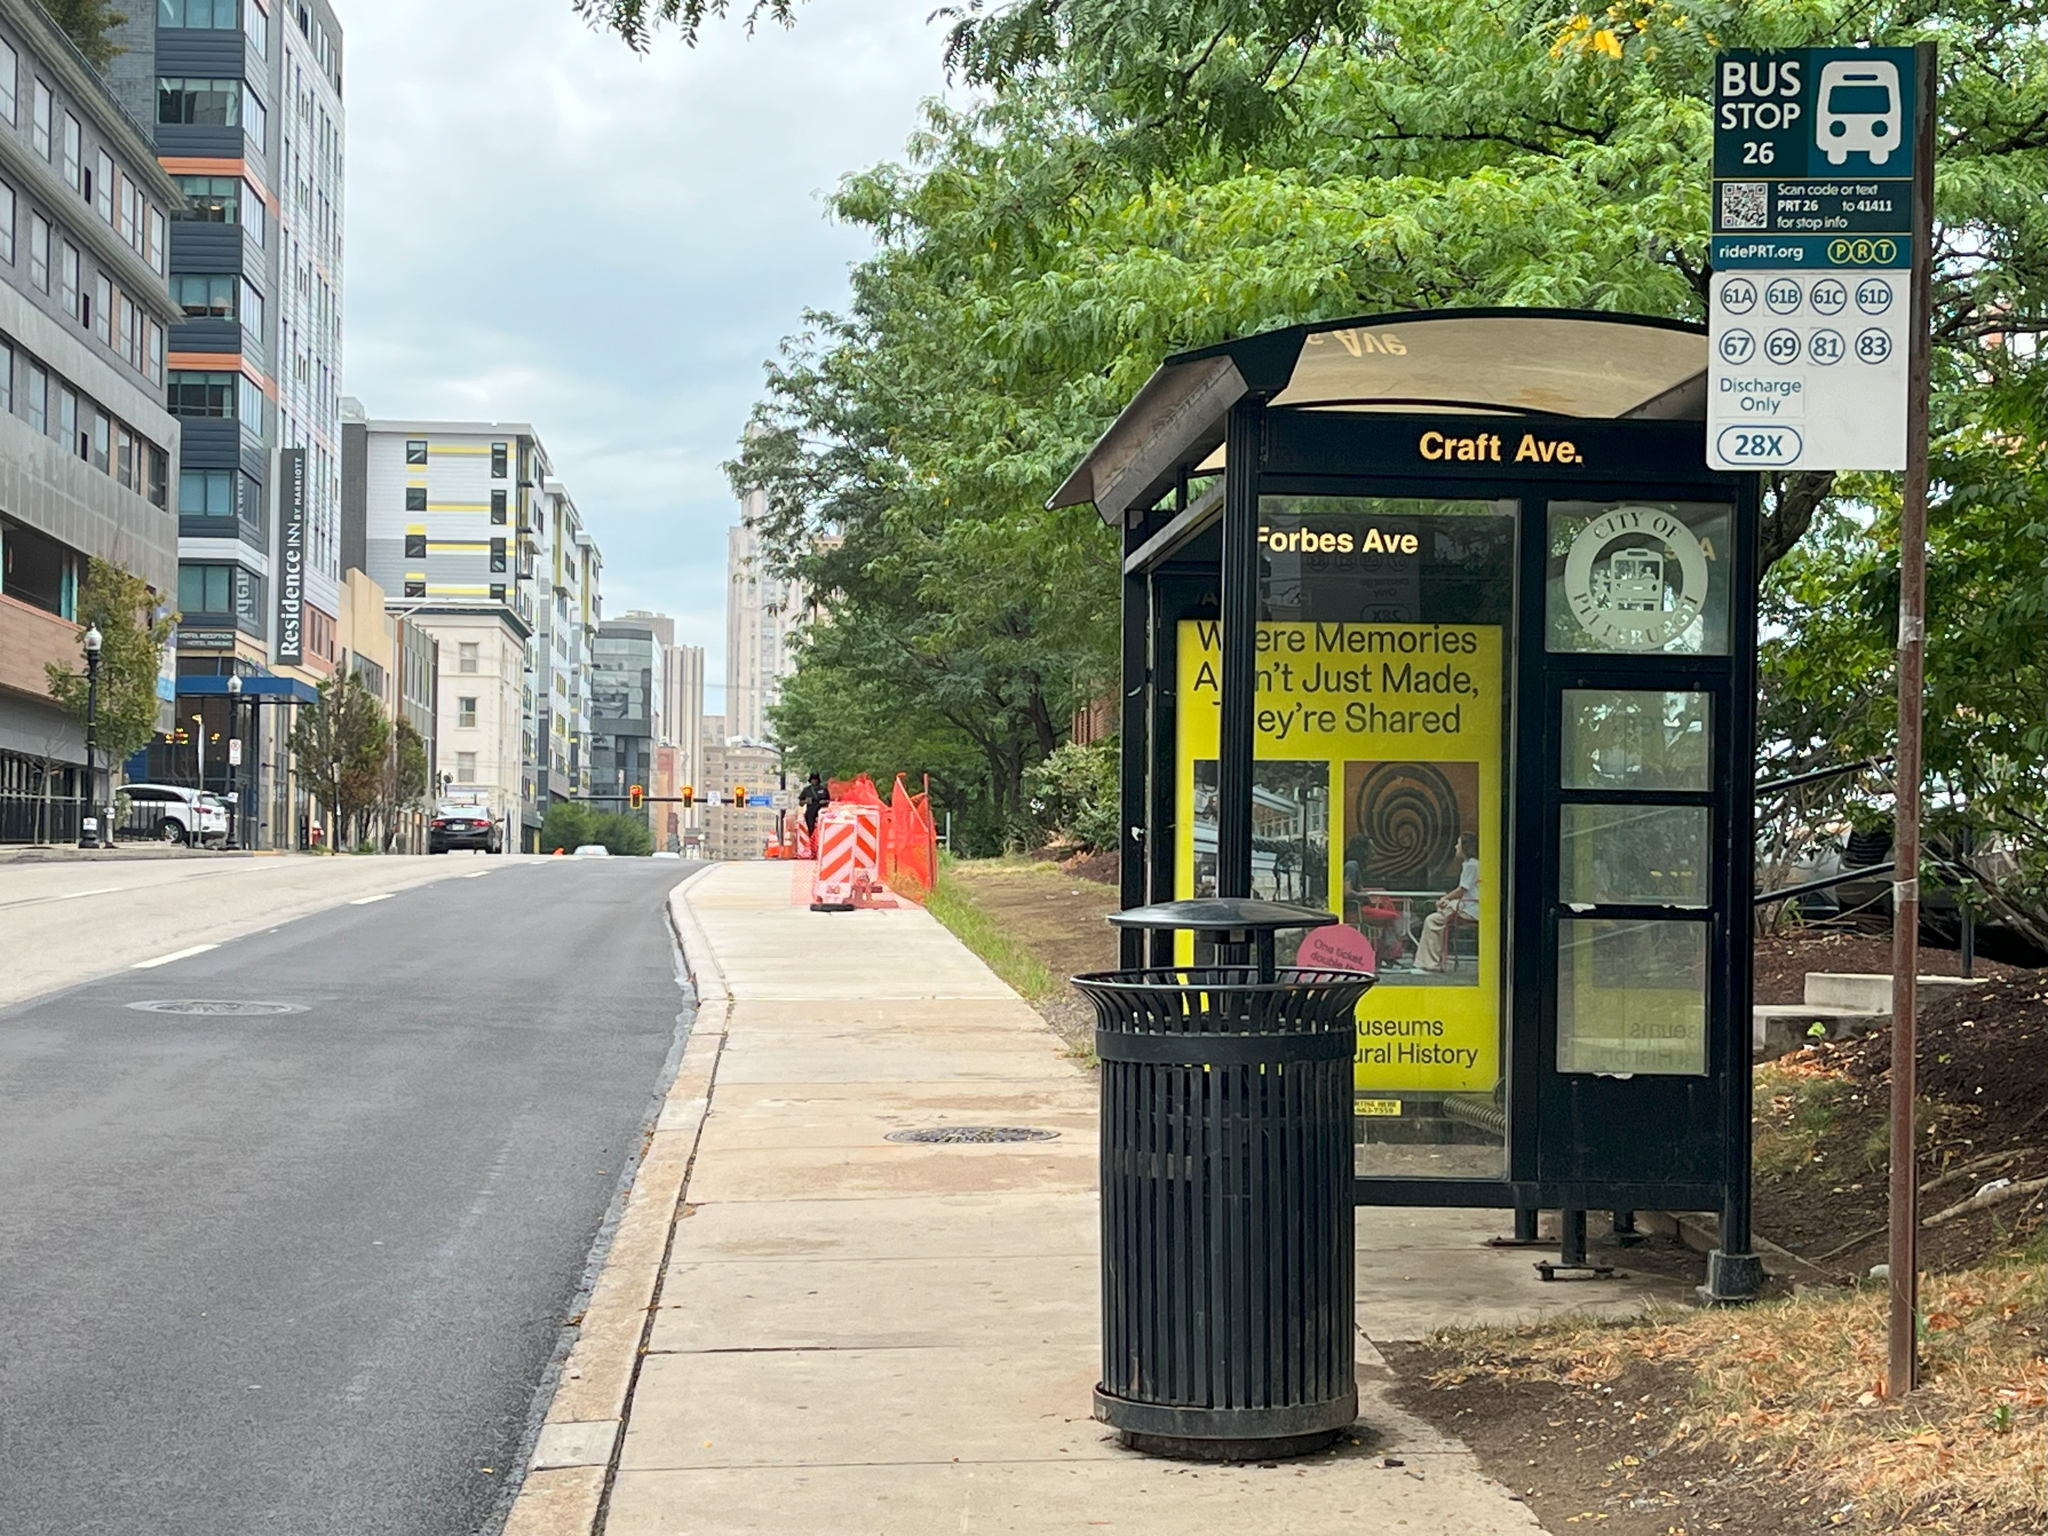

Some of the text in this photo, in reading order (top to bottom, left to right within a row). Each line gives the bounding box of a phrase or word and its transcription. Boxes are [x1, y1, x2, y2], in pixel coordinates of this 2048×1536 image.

[1722, 61, 1801, 97] BUS
[1721, 103, 1801, 130] STOP
[1743, 142, 1775, 165] 26
[1777, 184, 1878, 196] Scan code or text
[1777, 200, 1892, 212] PRT 26 to 41411
[1777, 217, 1848, 230] for stop info
[1719, 244, 1804, 261] ridePRT.org
[1723, 290, 1890, 305] 61A 61B 61C 61D
[1724, 336, 1887, 357] 67 69 81 83
[1720, 378, 1802, 397] Discharge
[1740, 397, 1781, 415] Only
[1419, 431, 1583, 463] Craft Ave.
[1735, 434, 1783, 456] 28X
[1594, 511, 1645, 539] CITY
[1362, 528, 1419, 554] Ave
[281, 457, 302, 656] Residence INN BY MARRIOTT
[1196, 621, 1477, 654] Were Memories
[1193, 661, 1480, 699] An't Just Made,
[1212, 701, 1461, 740] ey're Shared
[1314, 939, 1334, 954] One
[1355, 1020, 1444, 1036] useums
[1398, 1042, 1478, 1069] History
